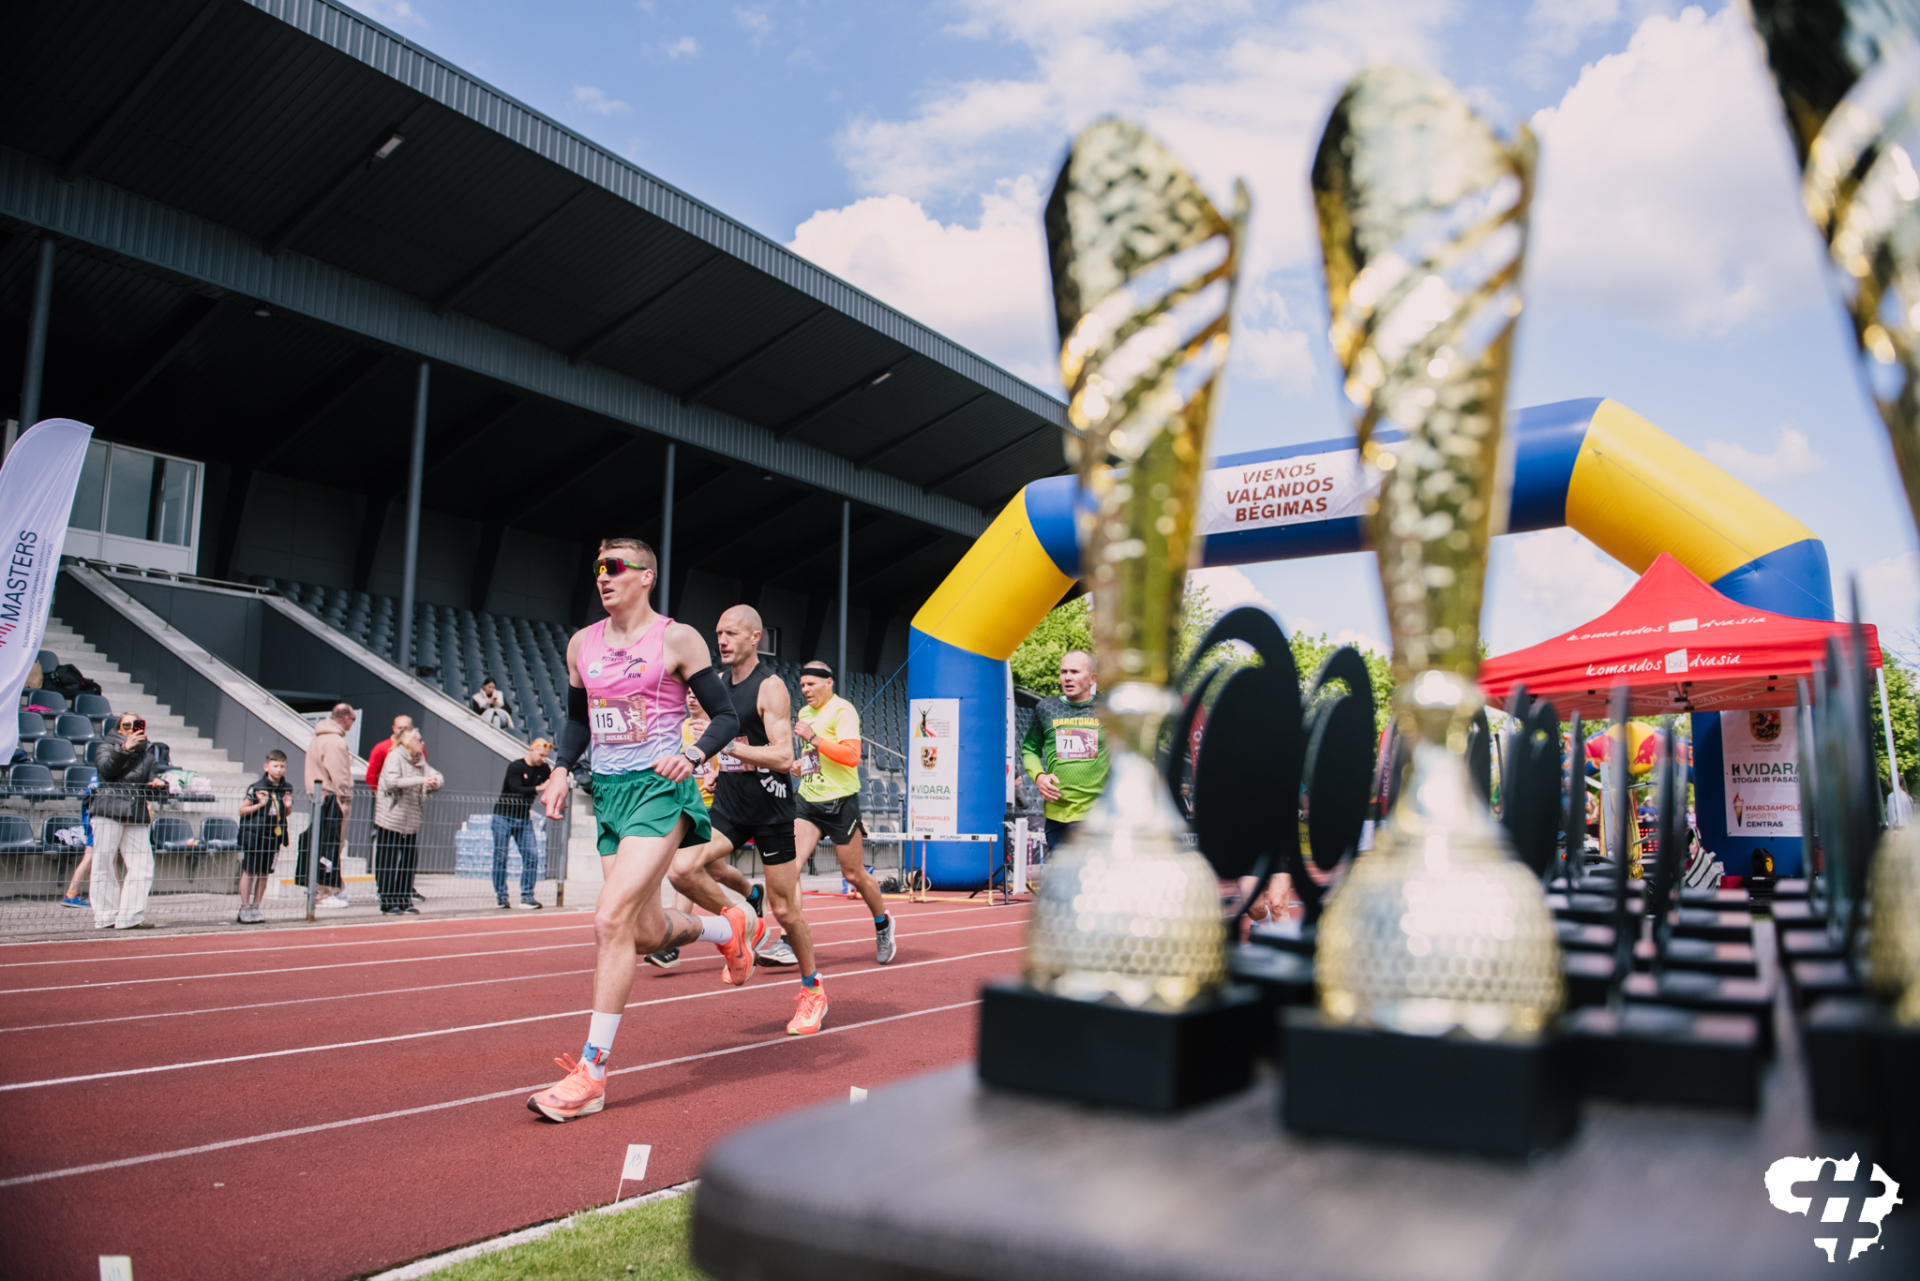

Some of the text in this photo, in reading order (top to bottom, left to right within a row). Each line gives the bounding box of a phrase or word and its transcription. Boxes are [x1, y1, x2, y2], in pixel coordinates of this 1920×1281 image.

[1243, 463, 1316, 484] VIENOS
[1227, 477, 1333, 504] VALANDOS
[1235, 497, 1327, 522] BĖGIMAS
[0, 530, 37, 621] MASTERS
[1566, 625, 1664, 641] komandos
[1699, 617, 1766, 628] dvasia
[1586, 658, 1662, 676] komandos
[1689, 653, 1740, 667] dvasia
[595, 713, 613, 728] 115
[1052, 717, 1099, 728] MARATONAS
[1063, 739, 1073, 749] 71
[916, 785, 951, 794] VIDARA
